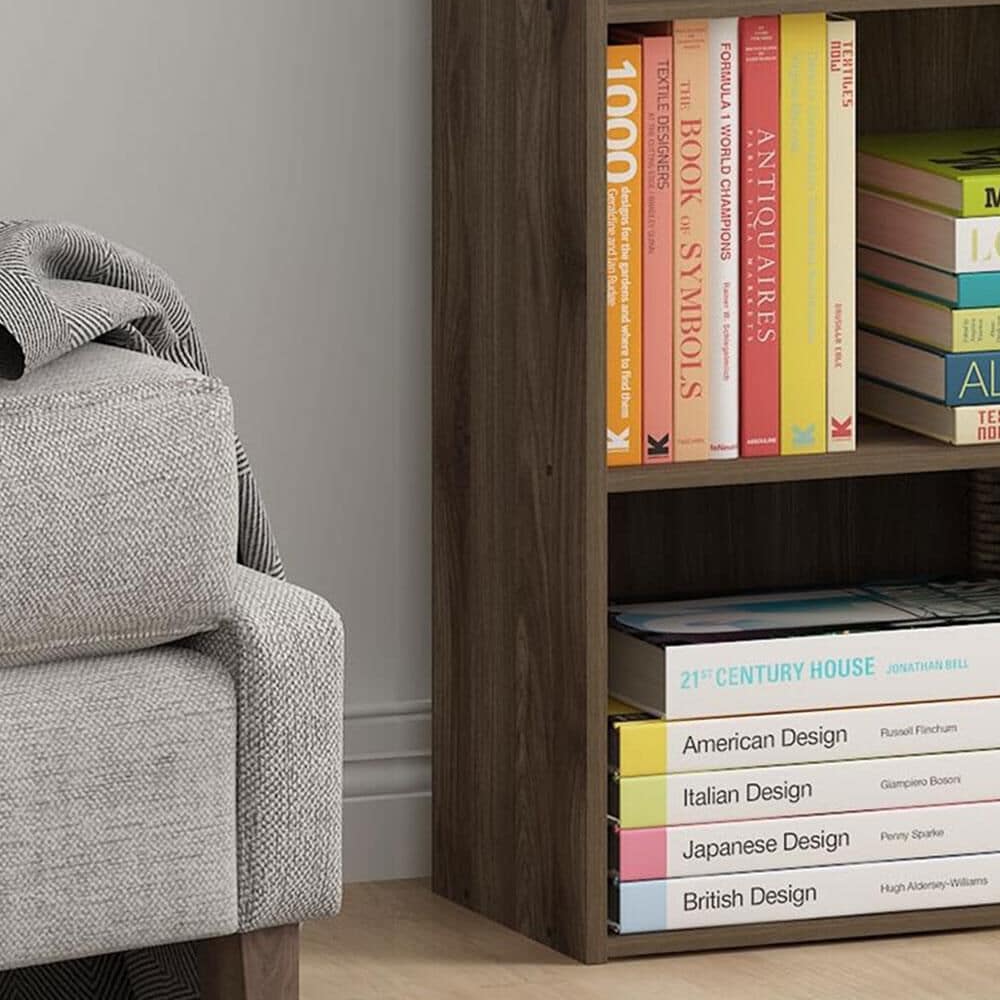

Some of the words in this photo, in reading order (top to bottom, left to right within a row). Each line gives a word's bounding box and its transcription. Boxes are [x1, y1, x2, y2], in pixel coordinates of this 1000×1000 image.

[657, 59, 669, 111] TEXTILE
[720, 42, 732, 110] FORMULA
[842, 41, 852, 108] TEXTILES
[680, 80, 690, 110] THE
[607, 60, 638, 183] 1000
[657, 115, 669, 191] DESIGNERS
[680, 119, 702, 206] BOOK
[720, 124, 732, 175] WORLD
[620, 227, 631, 242] for
[680, 215, 690, 235] OF
[720, 179, 732, 261] CHAMPIONS
[752, 128, 777, 343] ANTIQUAIRES
[620, 243, 631, 260] the
[619, 262, 631, 302] gardens
[620, 303, 631, 323] and
[680, 242, 703, 400] SYMBOLS
[620, 325, 631, 356] where
[620, 358, 631, 368] to
[620, 370, 632, 391] find
[715, 662, 804, 687] CENTURY
[809, 656, 875, 679] HOUSE
[886, 659, 943, 675] JONATHAN
[945, 658, 969, 671] BELL
[682, 731, 775, 755] American
[781, 726, 848, 749] Design
[880, 725, 913, 738] Russell
[915, 723, 958, 735] Flinchum
[683, 786, 739, 807] Italian
[746, 780, 812, 804] Design
[880, 778, 928, 790] Giampiero
[682, 837, 777, 861] Japanese
[784, 830, 850, 853] Design
[880, 831, 909, 843] Penny
[911, 828, 944, 842] Sparke
[684, 889, 743, 911] British
[751, 884, 817, 907] Design
[880, 883, 906, 895] Hugh
[906, 877, 988, 891] Aldersey-Williams
